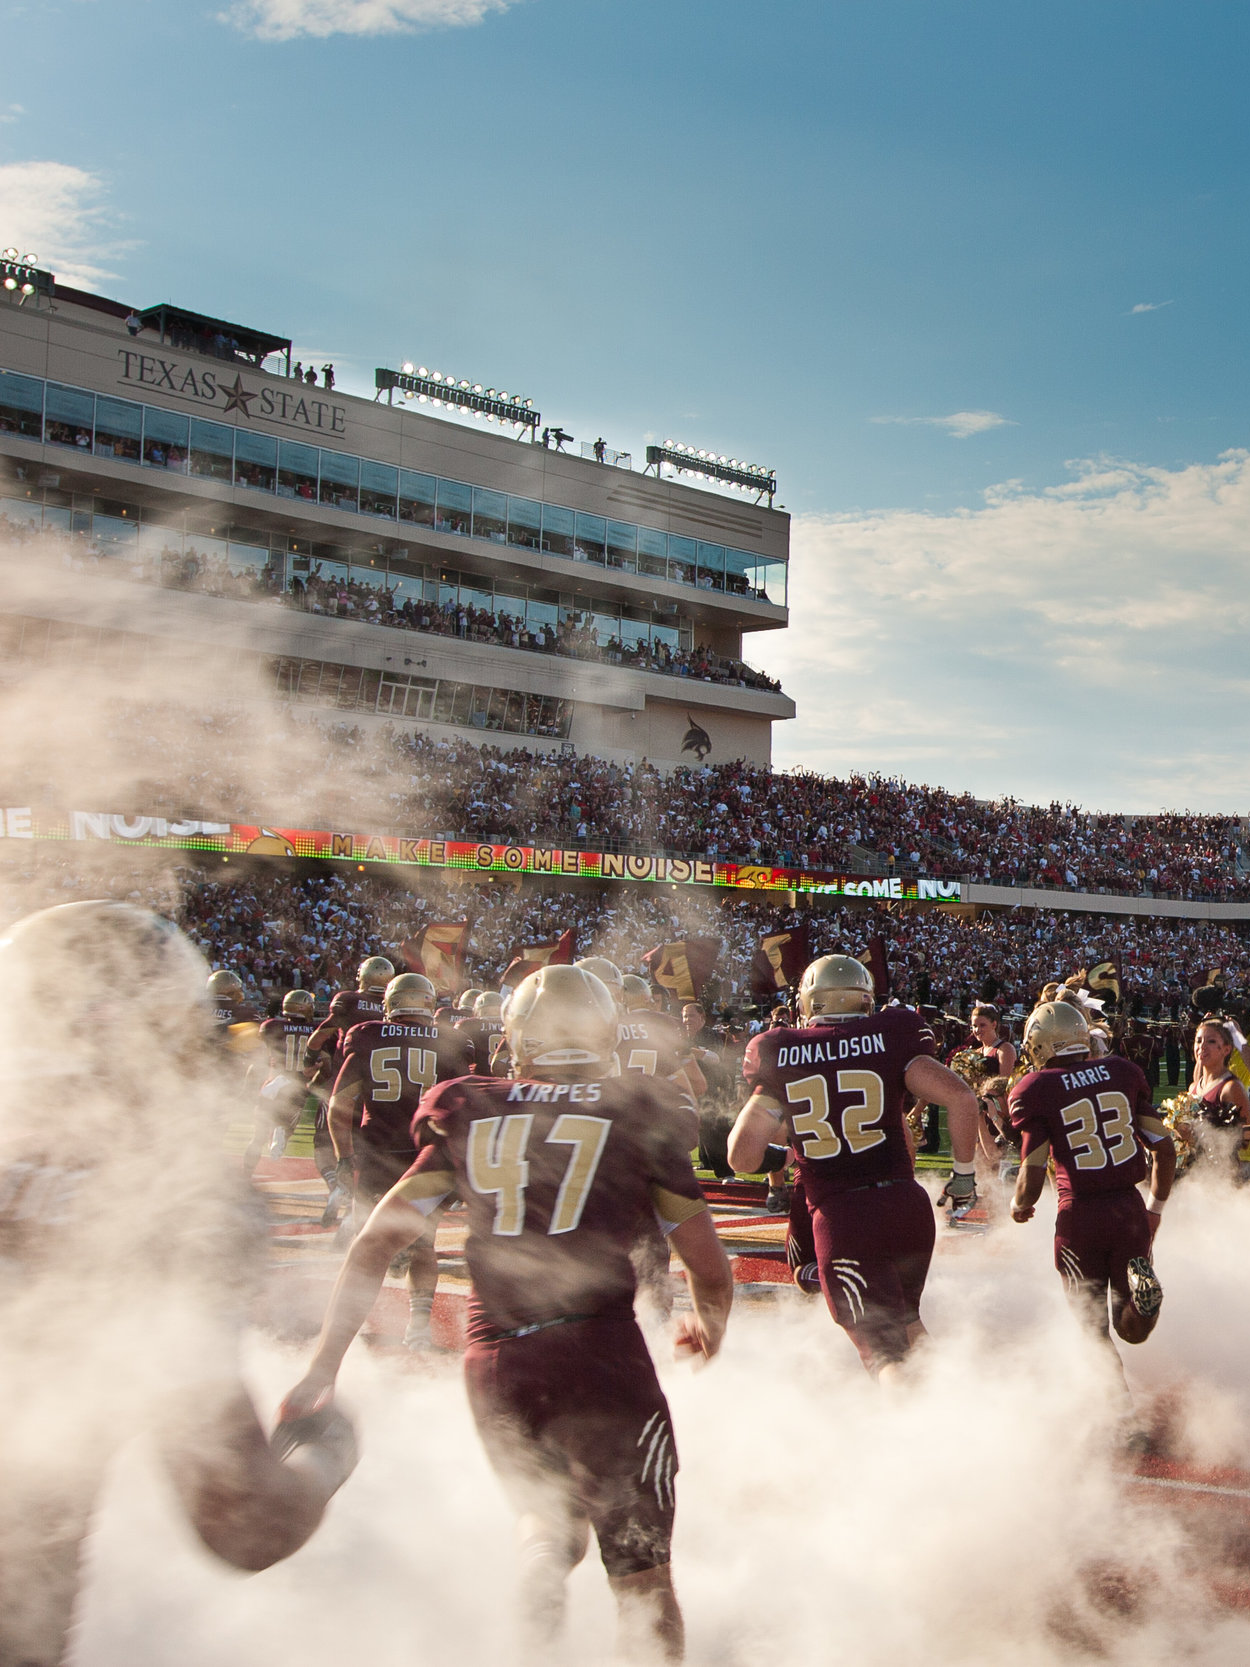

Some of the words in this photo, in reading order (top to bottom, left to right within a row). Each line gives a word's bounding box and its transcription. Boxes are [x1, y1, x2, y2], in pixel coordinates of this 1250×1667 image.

[118, 349, 217, 400] TEXAS
[260, 387, 347, 433] STATE
[332, 833, 447, 865] MAKE
[477, 843, 579, 873] SOME
[601, 852, 715, 884] NOISE
[283, 1023, 314, 1034] HAWKINS
[380, 1023, 439, 1039] COSTELLO
[777, 1032, 886, 1068] DONALDSON
[370, 1046, 438, 1102] 54
[507, 1082, 602, 1103] KIRPES
[1060, 1064, 1111, 1092] FARRIS
[785, 1069, 887, 1160] 32
[1059, 1091, 1138, 1171] 33
[465, 1113, 614, 1237] 47
